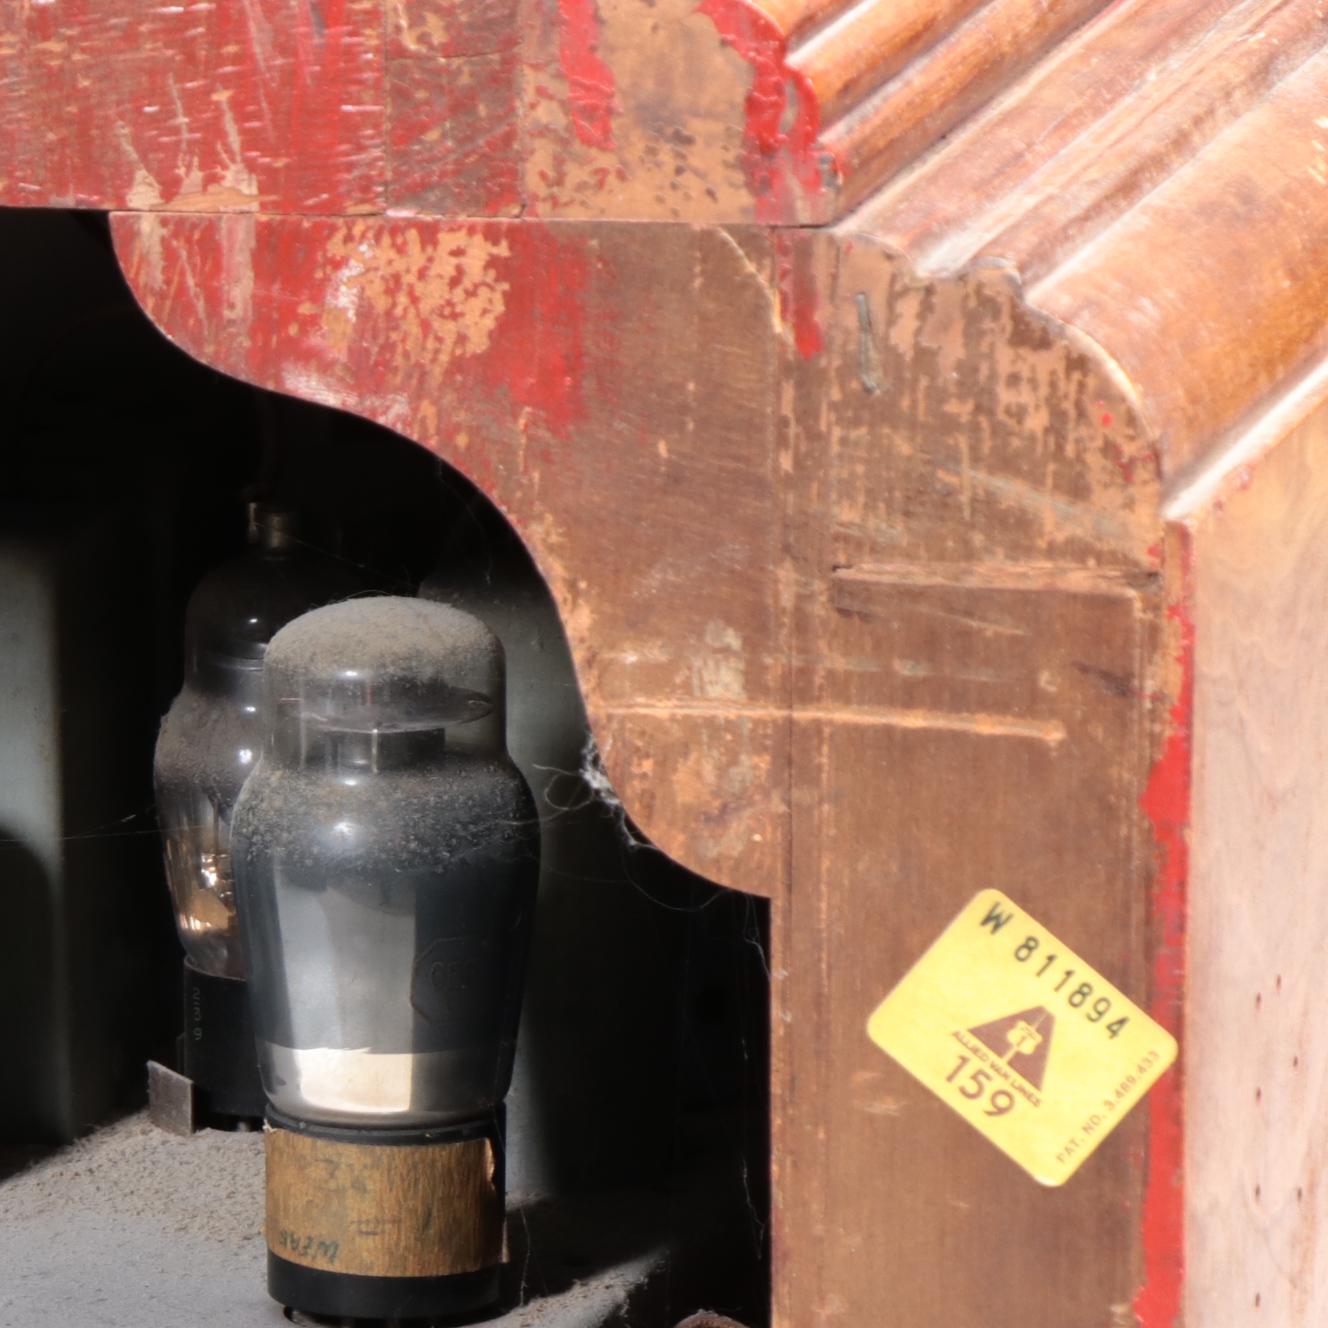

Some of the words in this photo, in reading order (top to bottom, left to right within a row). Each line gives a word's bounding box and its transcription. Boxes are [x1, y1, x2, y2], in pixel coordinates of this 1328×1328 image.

[980, 901, 1014, 935] W
[1014, 936, 1131, 1040] 811894
[945, 1054, 1015, 1117] 159
[951, 1031, 989, 1062] ALLIED
[989, 1060, 1011, 1081] VAN
[1010, 1079, 1041, 1108] LINES
